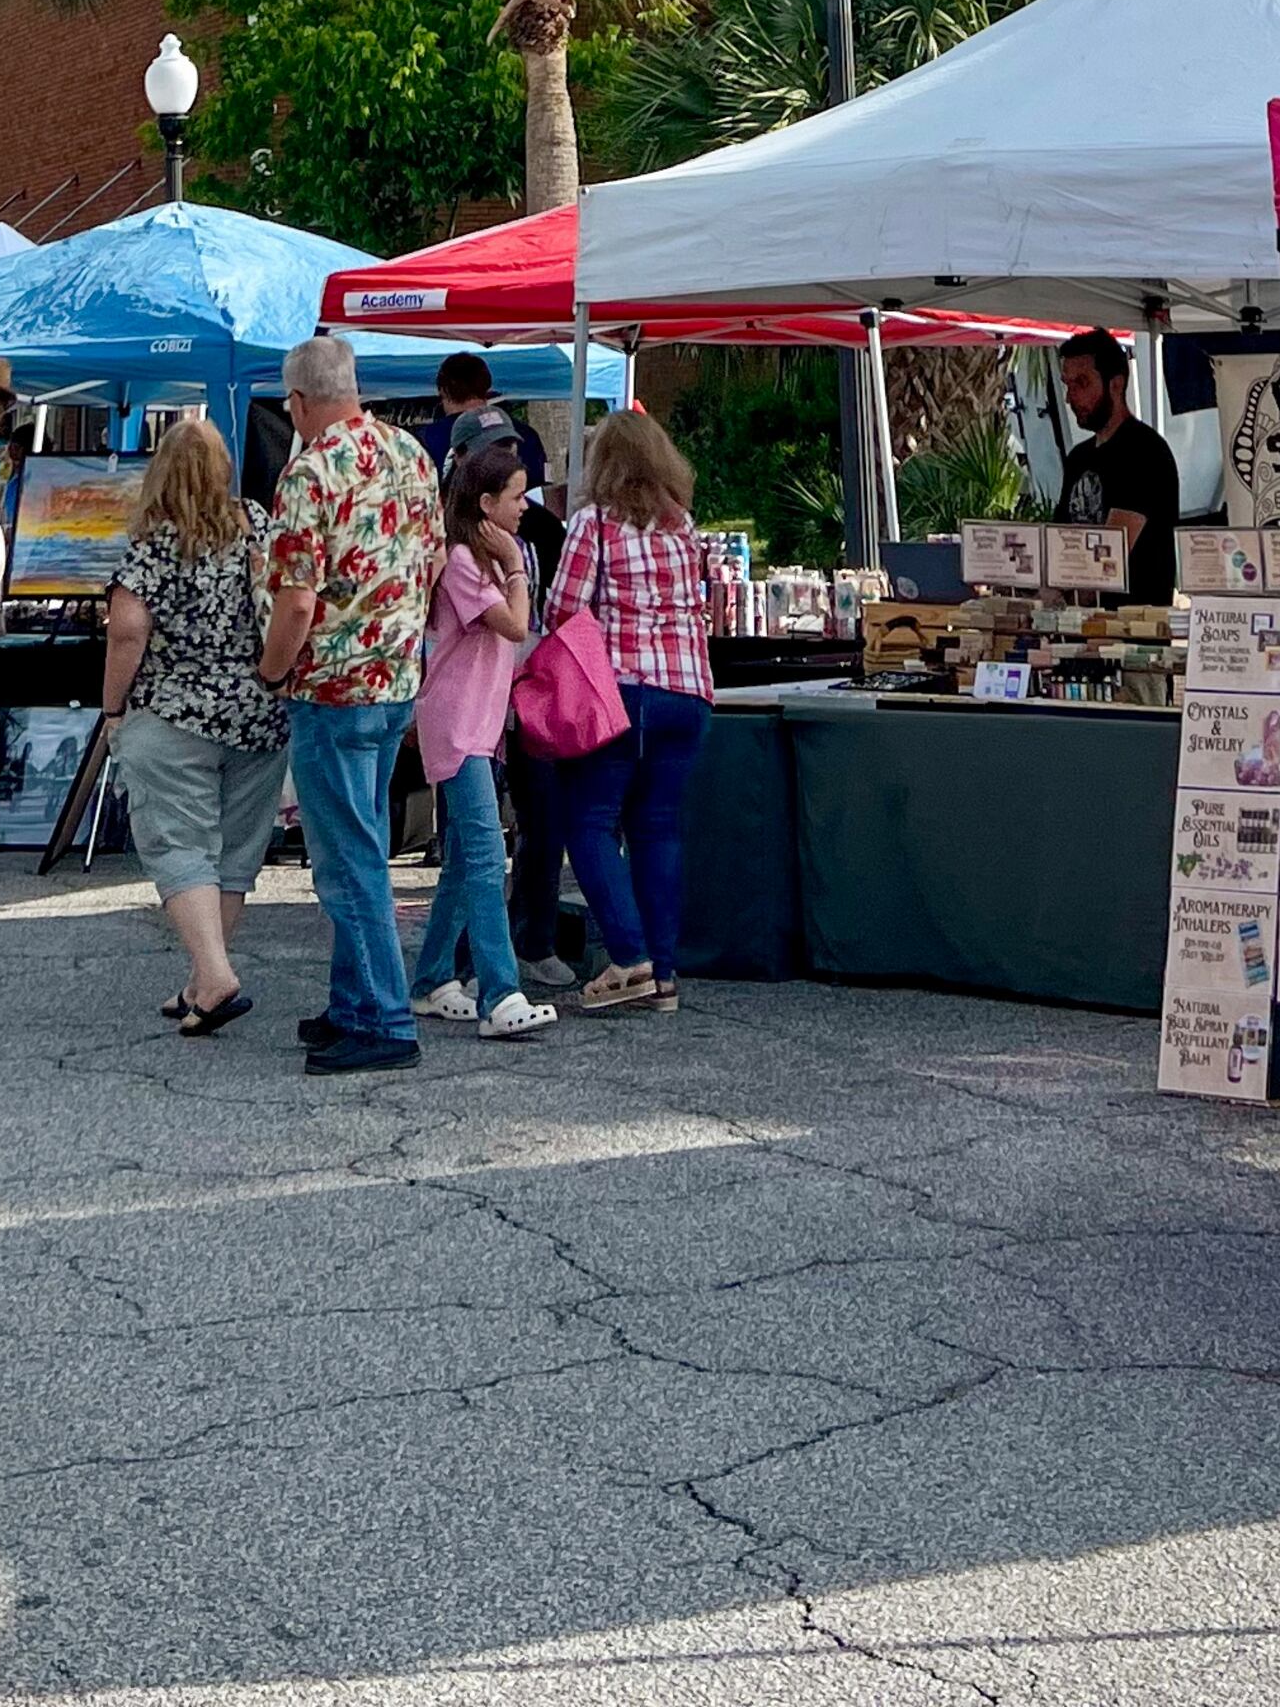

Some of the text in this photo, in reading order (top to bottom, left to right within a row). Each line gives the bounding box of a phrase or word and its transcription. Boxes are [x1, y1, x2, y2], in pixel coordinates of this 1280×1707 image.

[360, 292, 426, 310] Academy
[1195, 609, 1248, 625] NATURAL
[1200, 626, 1241, 643] SOAPS
[1187, 701, 1249, 721] CRYSTALS
[1186, 733, 1245, 753] JEWELRY
[1191, 799, 1225, 817] PURE
[1173, 896, 1272, 920] AROMATHERAPY
[1173, 915, 1232, 934] INHALERS
[1173, 997, 1222, 1016] NATURAL
